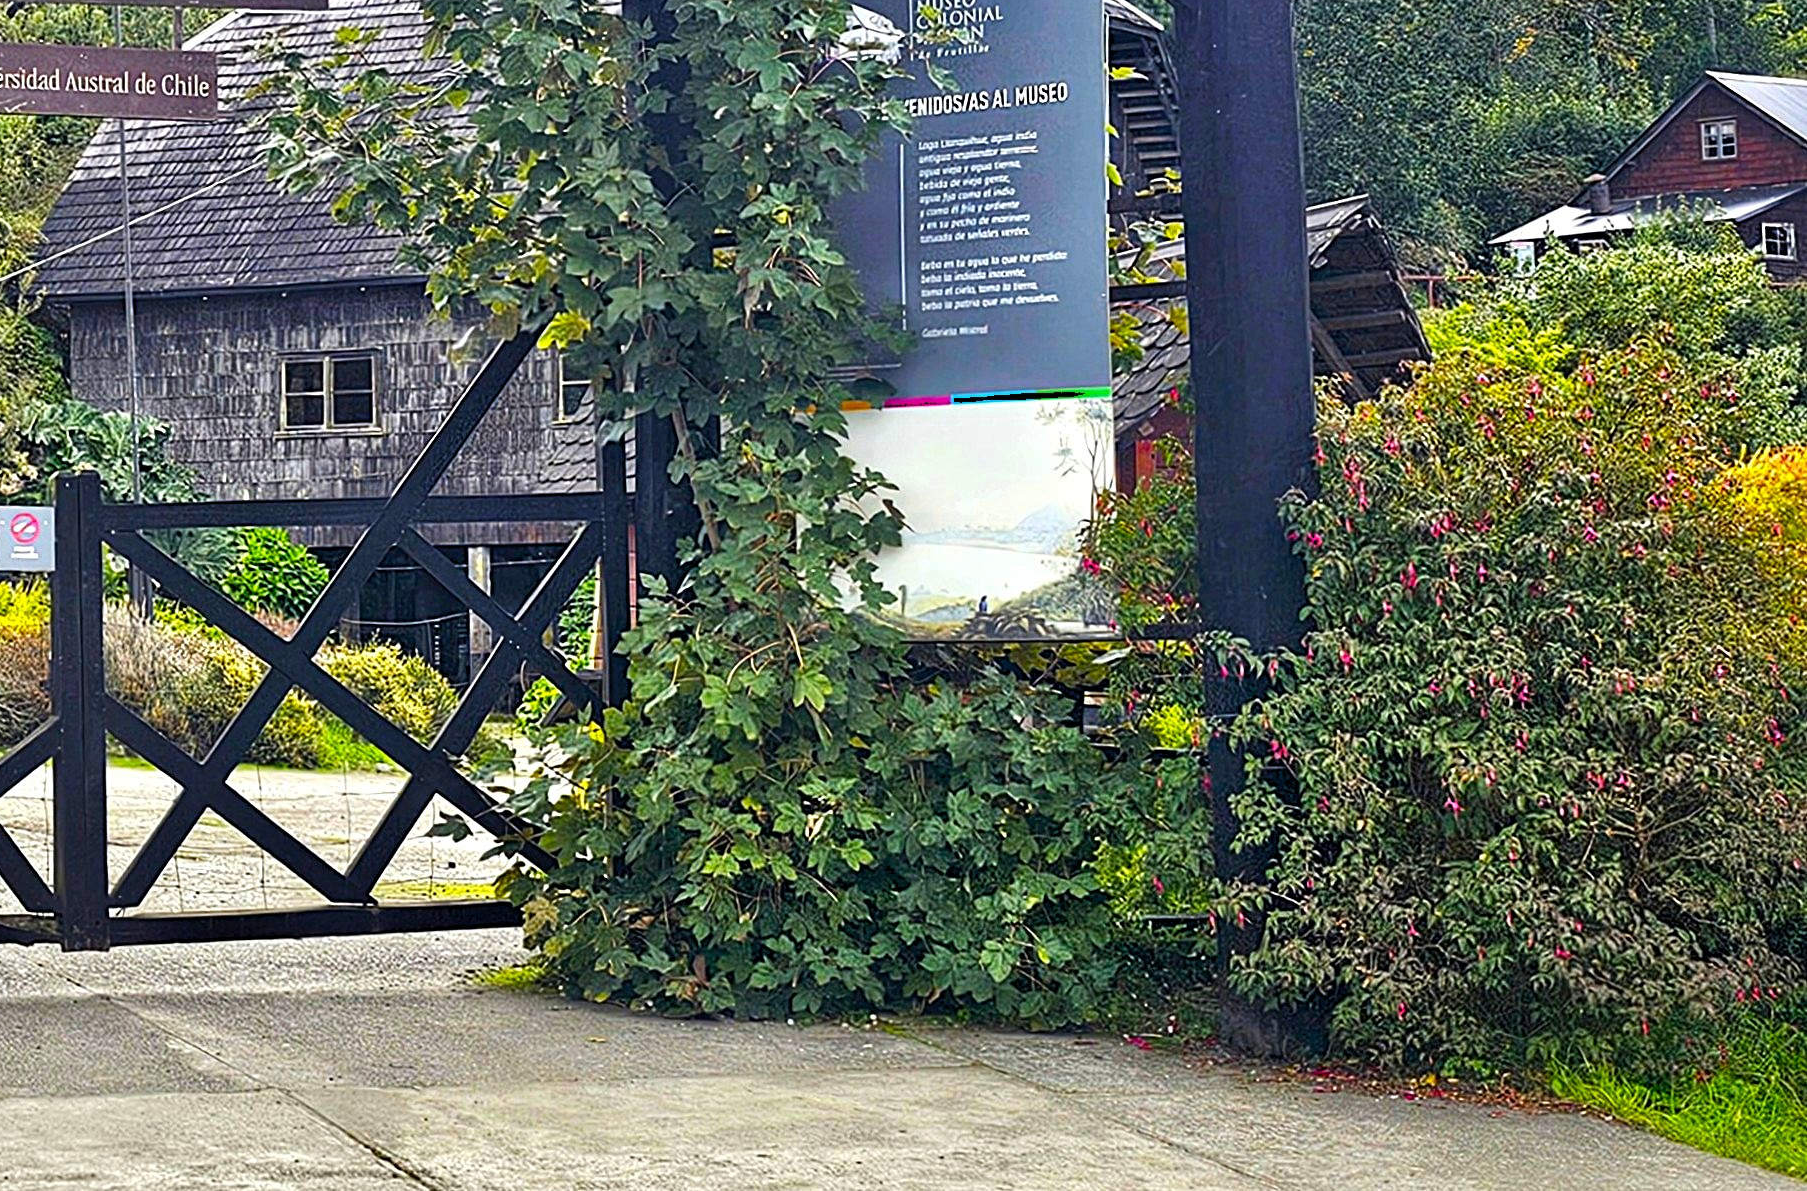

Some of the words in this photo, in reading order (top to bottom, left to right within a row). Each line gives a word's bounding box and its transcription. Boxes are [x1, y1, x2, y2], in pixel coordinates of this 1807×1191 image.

[65, 70, 129, 95] Austral
[135, 72, 157, 95] de
[161, 74, 210, 98] Chile
[904, 91, 990, 117] ENIDOS/AS
[992, 88, 1012, 109] AL
[1015, 82, 1068, 107] MUSEO
